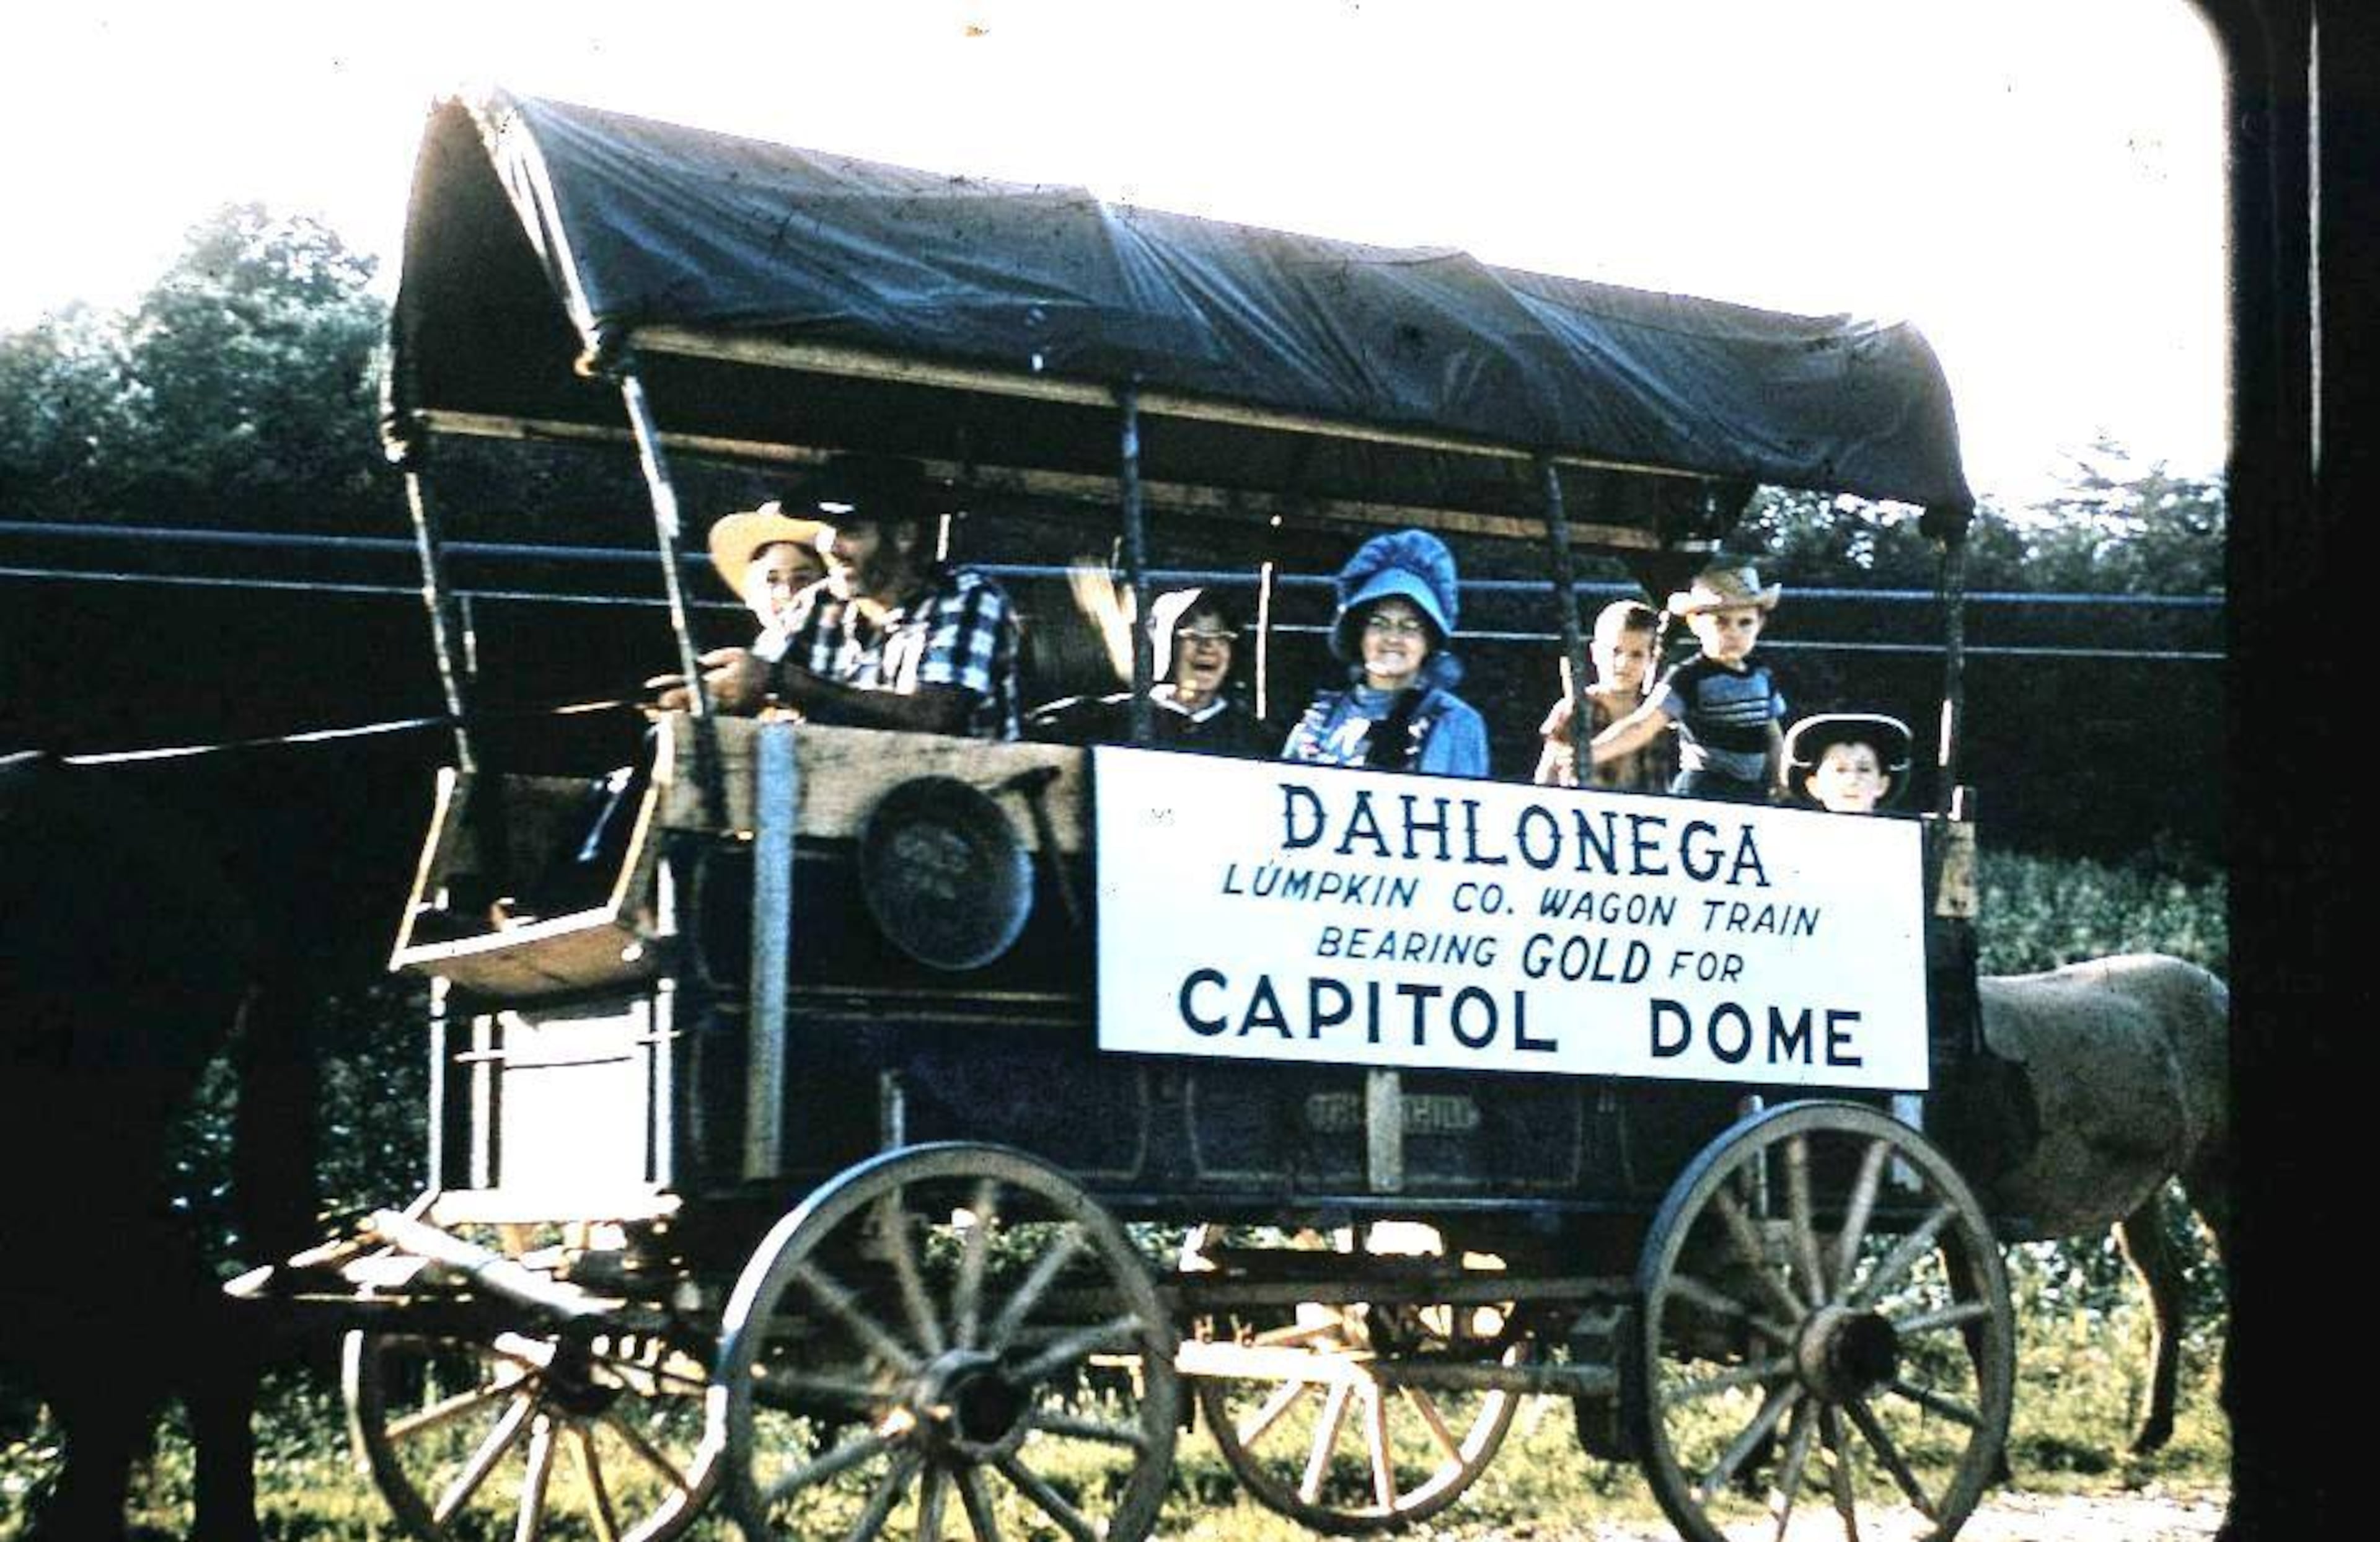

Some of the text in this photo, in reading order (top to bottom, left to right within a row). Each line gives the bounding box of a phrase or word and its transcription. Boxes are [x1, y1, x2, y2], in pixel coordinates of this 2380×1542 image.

[1279, 784, 1770, 886] DAHLONEGA
[1223, 865, 1818, 935] LUMPKIN CO. WAGON TRAIN
[1318, 927, 1743, 983] BEARING GOLD FOR
[1179, 969, 1861, 1067] CAPITOL DOME
